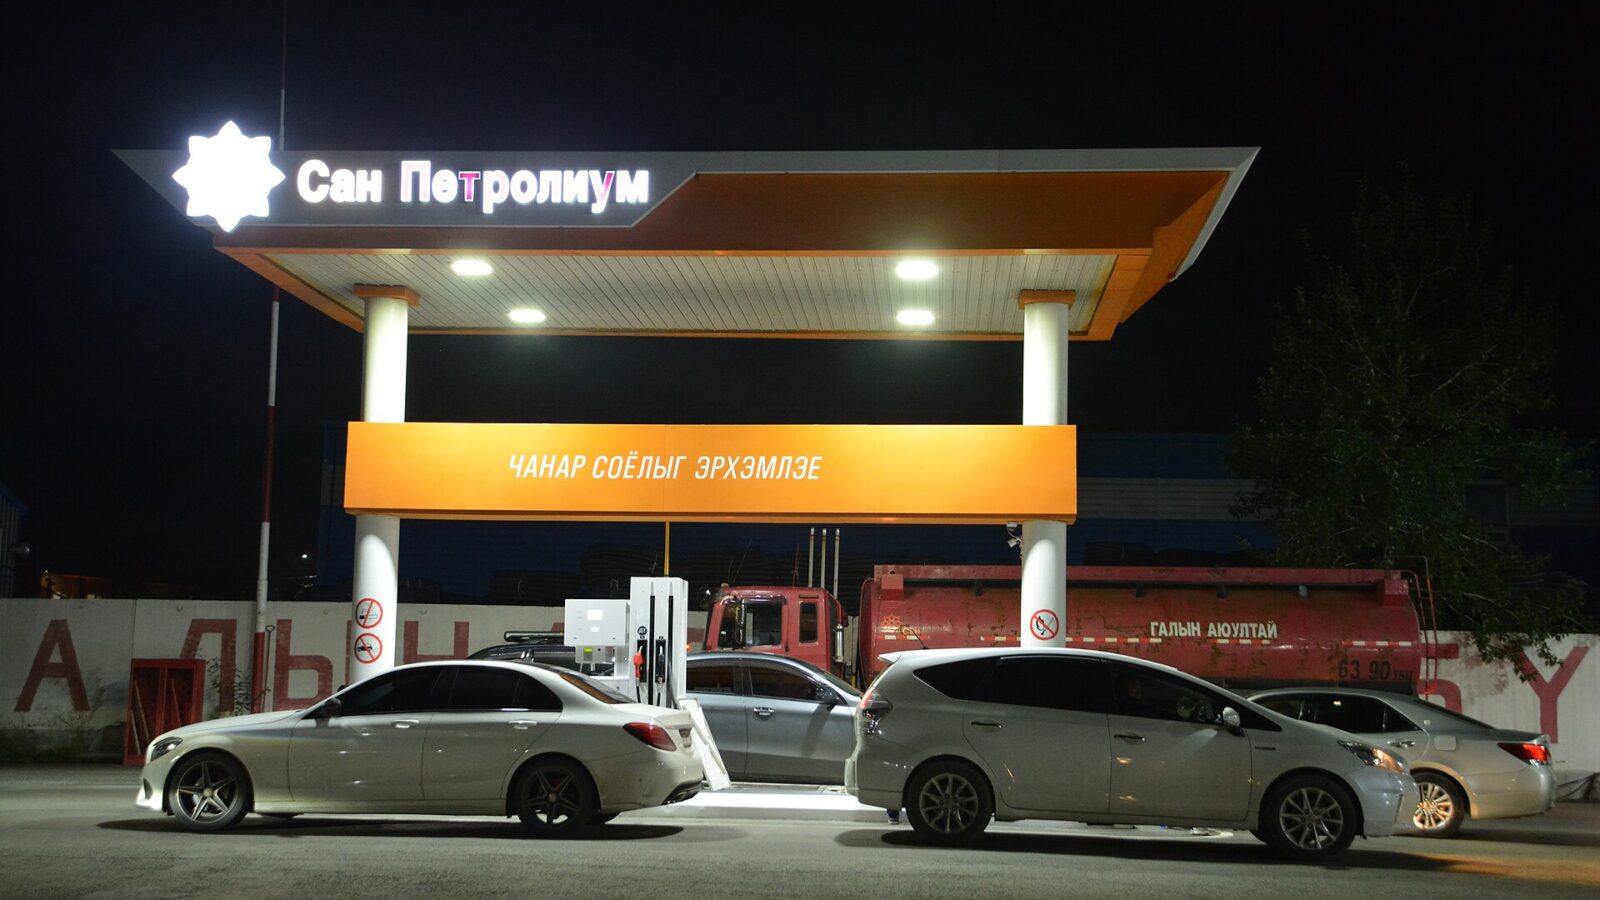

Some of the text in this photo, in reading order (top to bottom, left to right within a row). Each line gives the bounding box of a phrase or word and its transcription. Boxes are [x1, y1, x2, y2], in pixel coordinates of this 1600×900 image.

[296, 159, 650, 214] Сан Петролиум
[508, 450, 823, 481] ЧАНАР СОЁЛЫГ ЭРХЭМЛЭЕ
[1150, 619, 1278, 639] ГАЛЫН АЮУЛТАЙ
[1338, 659, 1360, 680] 63
[1369, 660, 1391, 681] 90
